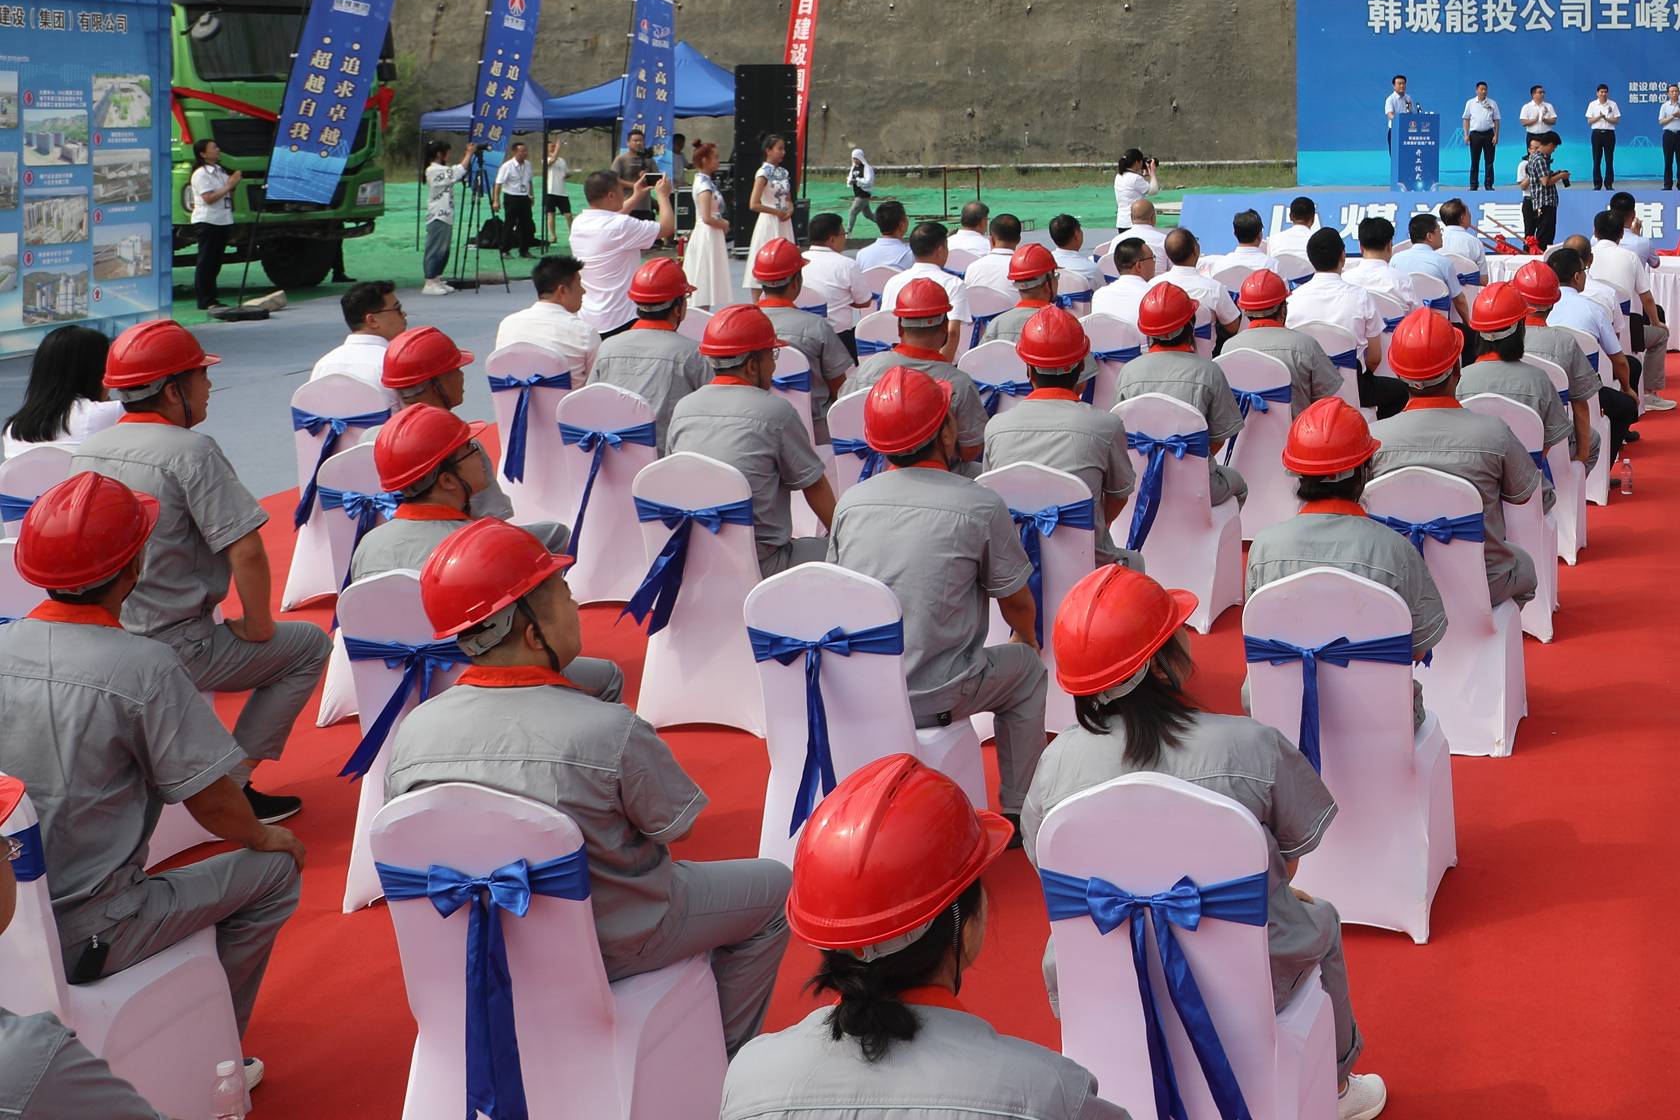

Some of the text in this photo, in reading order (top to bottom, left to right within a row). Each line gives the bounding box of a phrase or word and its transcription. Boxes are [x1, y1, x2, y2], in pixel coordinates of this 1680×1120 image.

[289, 48, 333, 141] 超越自我
[318, 55, 361, 147] 追求卓越
